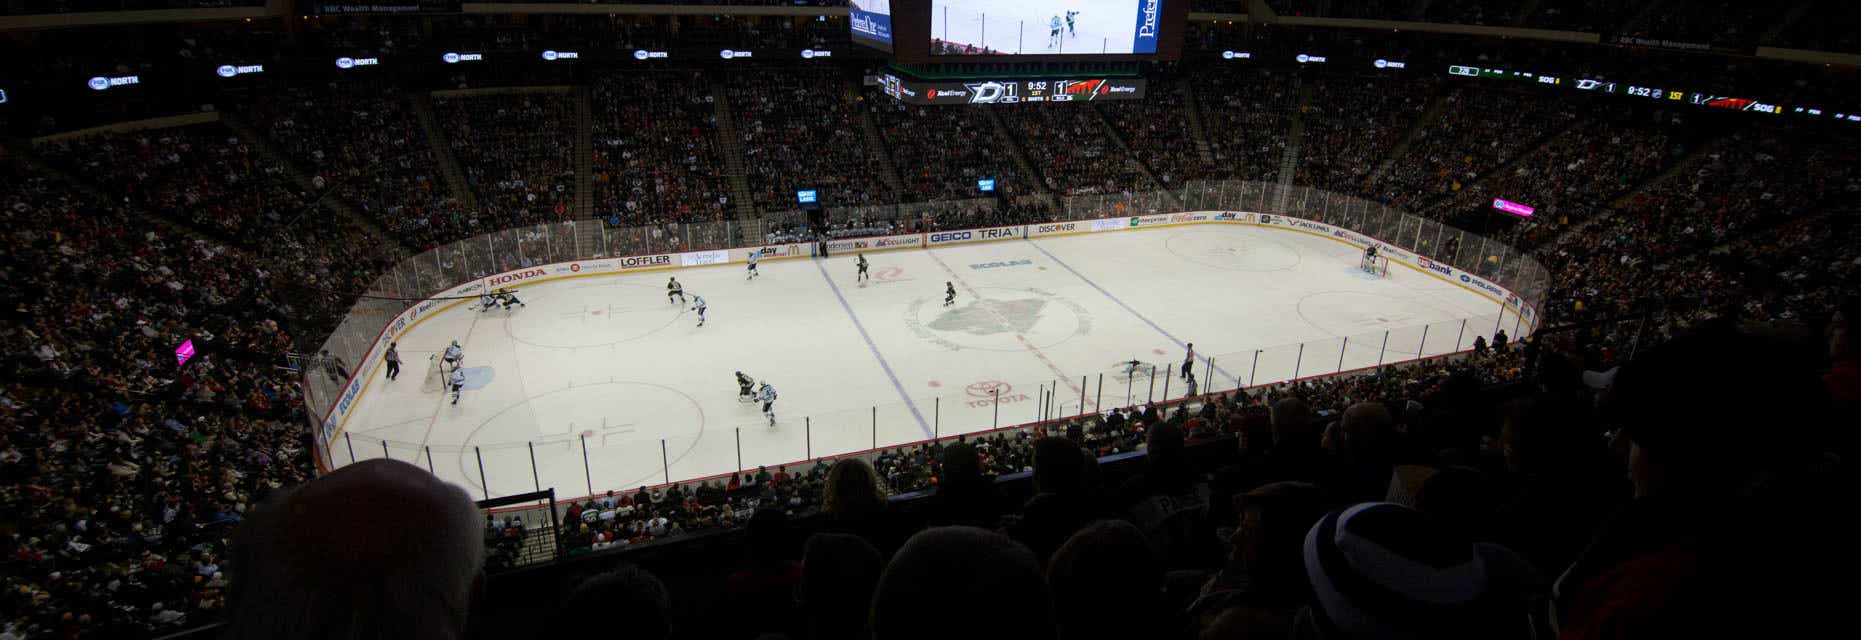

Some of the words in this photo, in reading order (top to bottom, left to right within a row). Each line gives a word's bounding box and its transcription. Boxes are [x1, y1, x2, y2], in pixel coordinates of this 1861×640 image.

[354, 58, 378, 66] NORTH
[238, 65, 263, 74] NORTH
[110, 75, 139, 86] NORTH
[1538, 76, 1554, 84] SOG
[1028, 81, 1047, 91] 9:52
[1628, 86, 1650, 97] 9:52
[1669, 91, 1684, 100] 1ST
[1753, 103, 1774, 113] SOG
[979, 228, 1012, 239] TRIA
[1040, 223, 1075, 233] DISCOVER
[931, 231, 972, 242] GEICO
[761, 246, 777, 255] day
[620, 255, 670, 267] LOFFLER
[1429, 261, 1452, 276] bank
[489, 269, 547, 286] HONDA
[1471, 279, 1502, 296] POLARIS
[339, 378, 360, 416] ECOLAB
[965, 394, 1032, 408] TOYOTA
